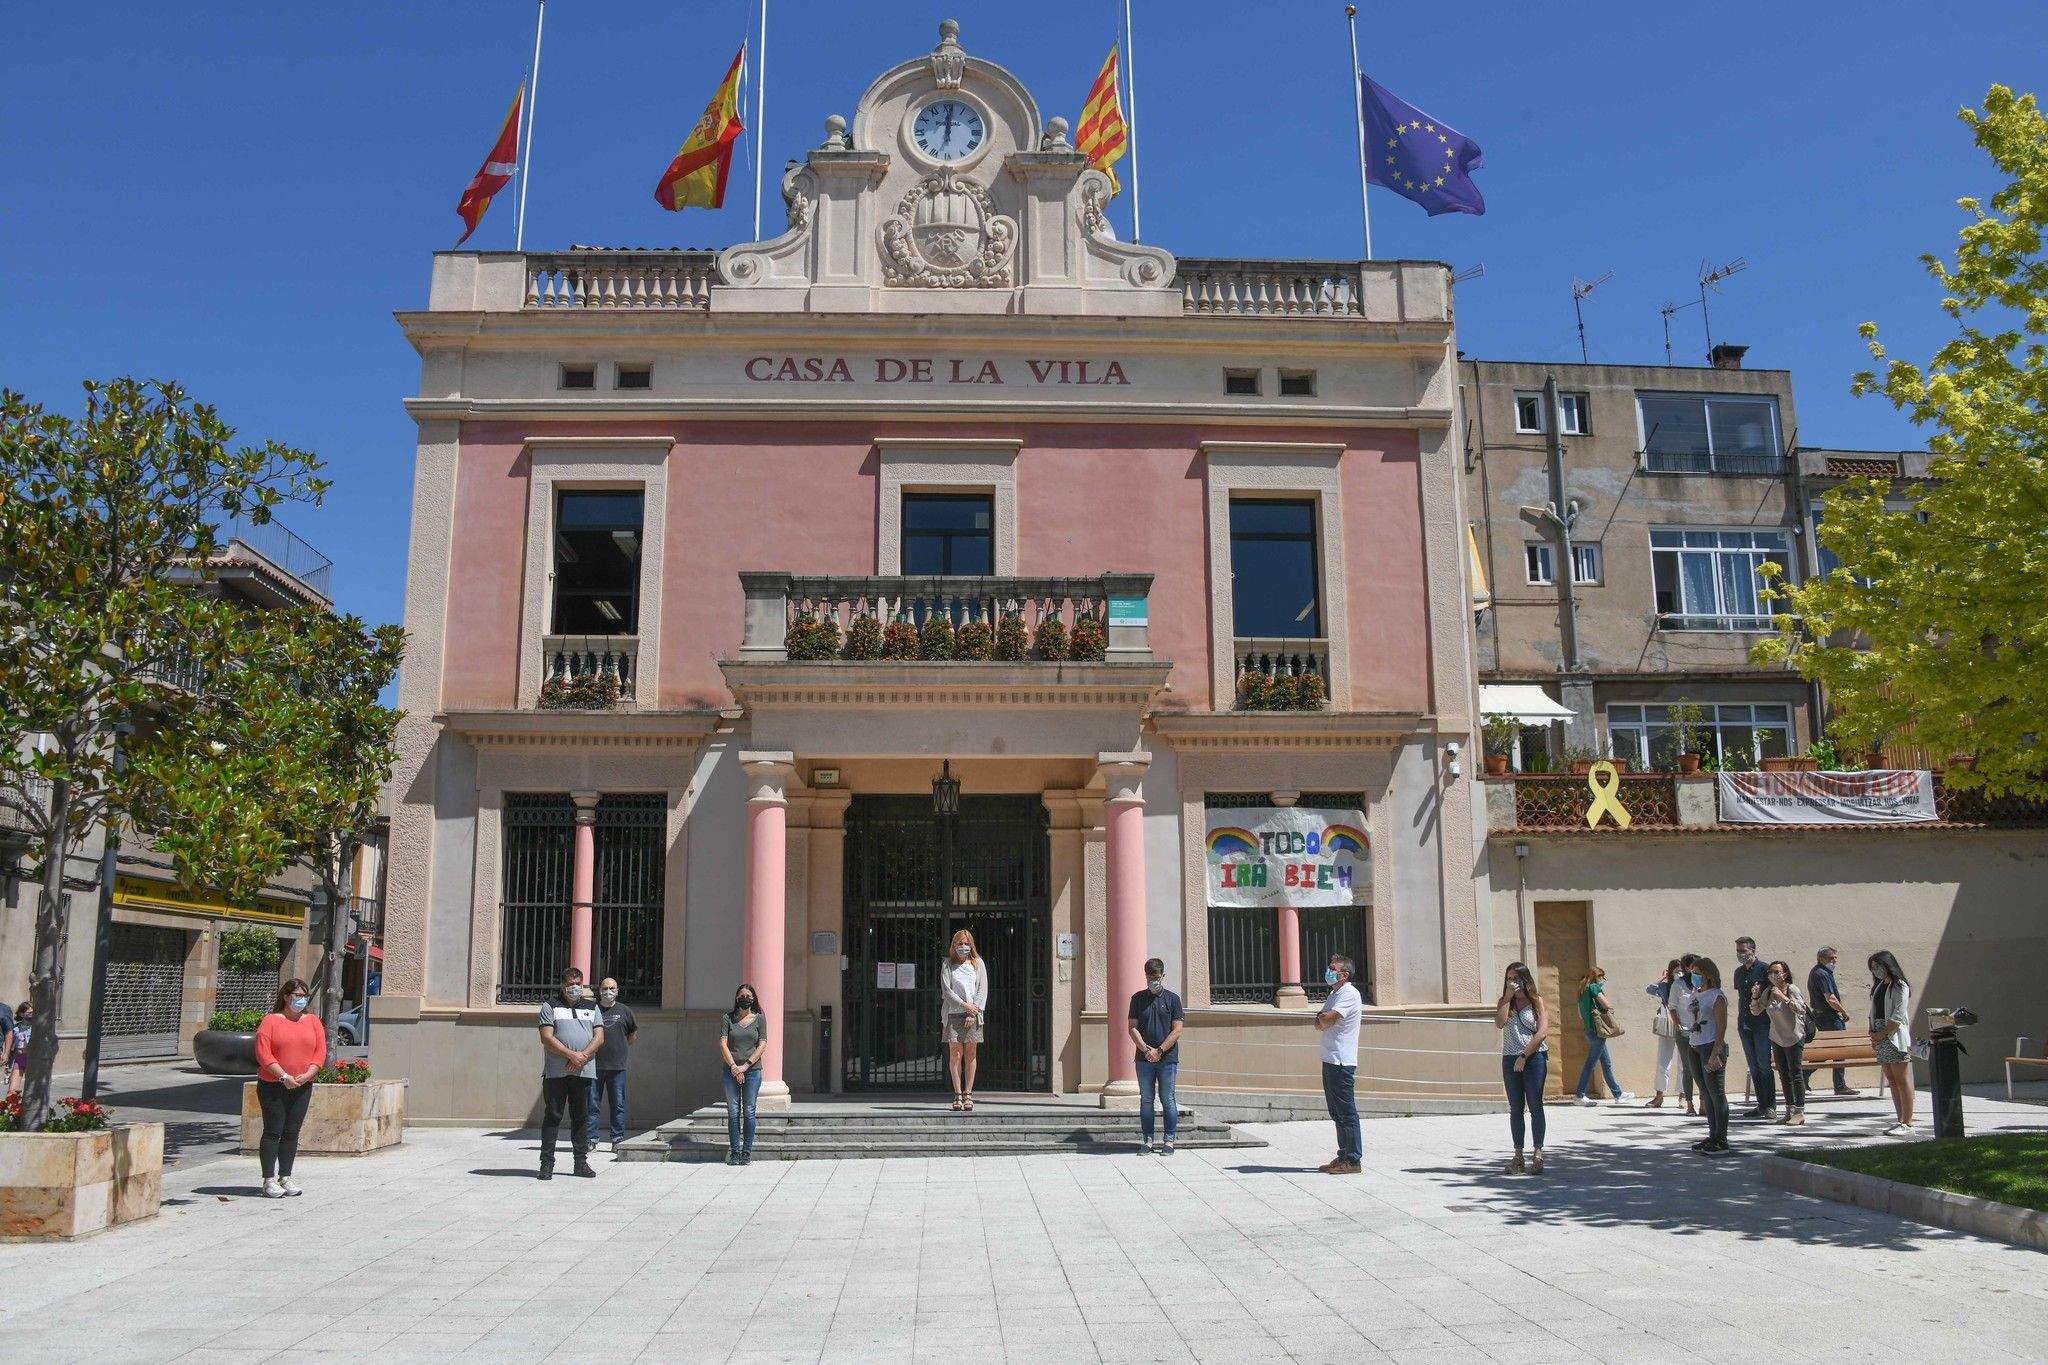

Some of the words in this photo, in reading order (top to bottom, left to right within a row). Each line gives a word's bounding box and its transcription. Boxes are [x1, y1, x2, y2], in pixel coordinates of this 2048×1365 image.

[744, 356, 855, 383] CASA
[875, 357, 934, 383] DE
[949, 359, 1004, 384] LA
[1025, 359, 1131, 385] VILA
[1259, 831, 1321, 855] TODO
[1285, 863, 1353, 890] BIEN
